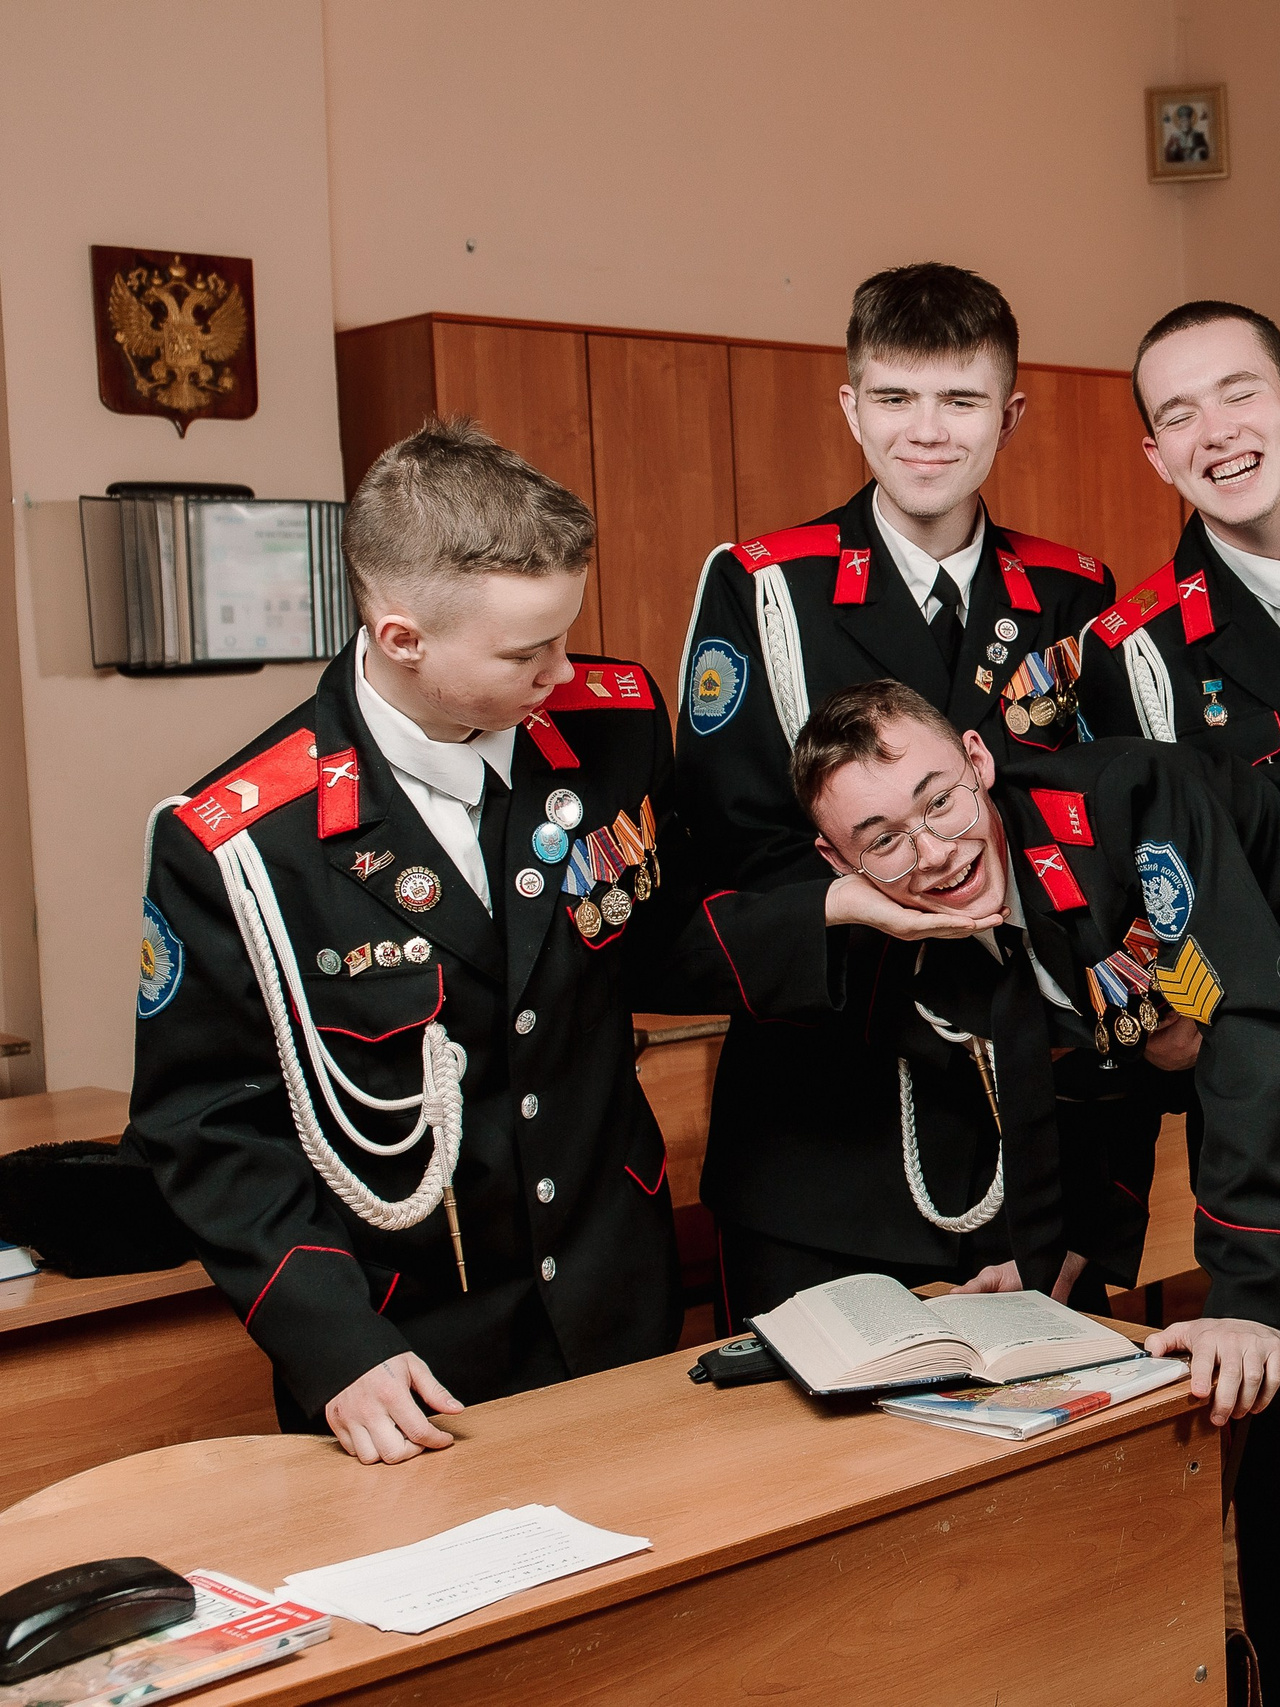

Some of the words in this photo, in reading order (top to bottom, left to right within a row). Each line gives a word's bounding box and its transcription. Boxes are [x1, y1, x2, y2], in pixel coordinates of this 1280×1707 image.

[742, 541, 772, 562] НК
[1101, 611, 1128, 634] НК
[614, 670, 642, 699] НК
[193, 797, 233, 832] НК
[1065, 805, 1083, 835] НК
[402, 874, 432, 893] ОТЛИЧНИК
[1161, 866, 1184, 889] КОРПУС
[195, 1593, 246, 1620] ЛОГИЯ
[234, 1613, 290, 1634] 11
